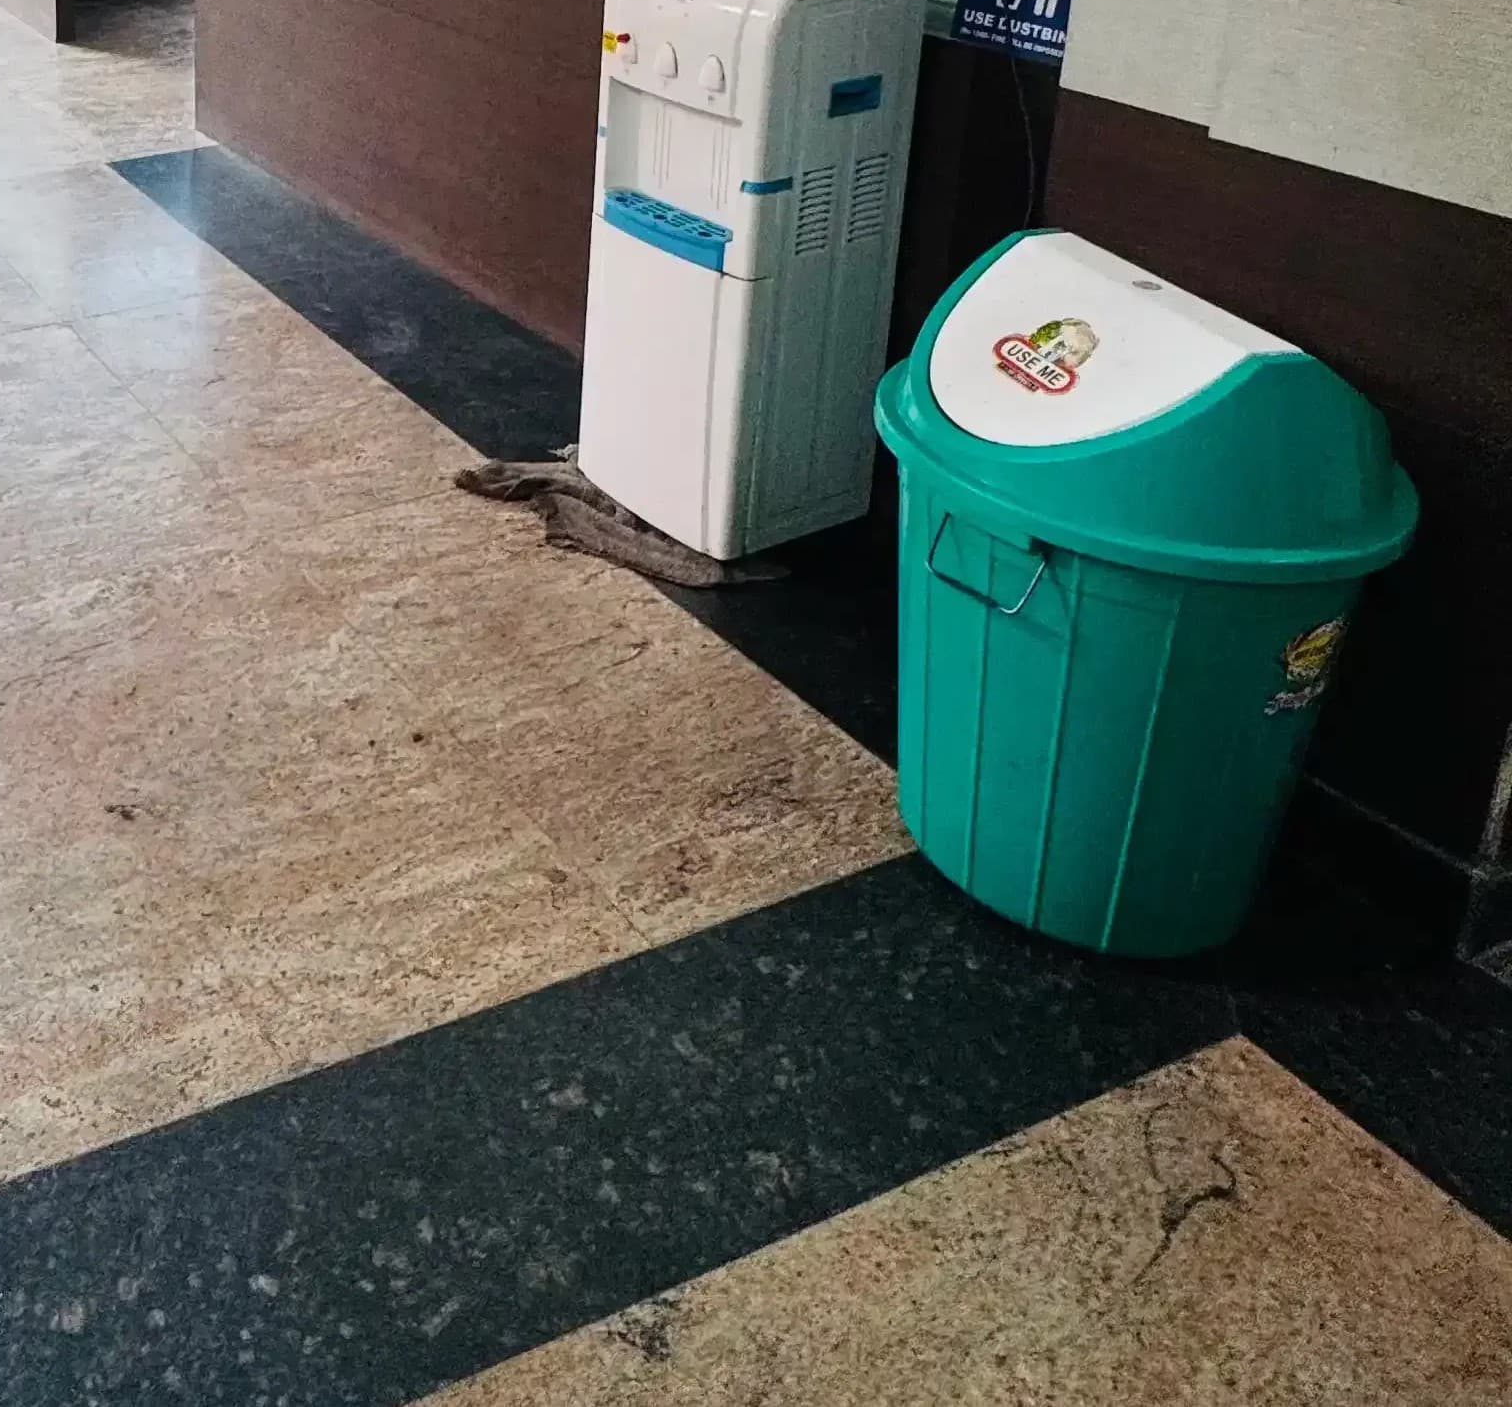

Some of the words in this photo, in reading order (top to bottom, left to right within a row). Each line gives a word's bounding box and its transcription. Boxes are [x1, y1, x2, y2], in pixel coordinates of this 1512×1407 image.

[963, 9, 996, 28] USE
[1007, 343, 1041, 370] USE
[1036, 365, 1066, 386] ME
